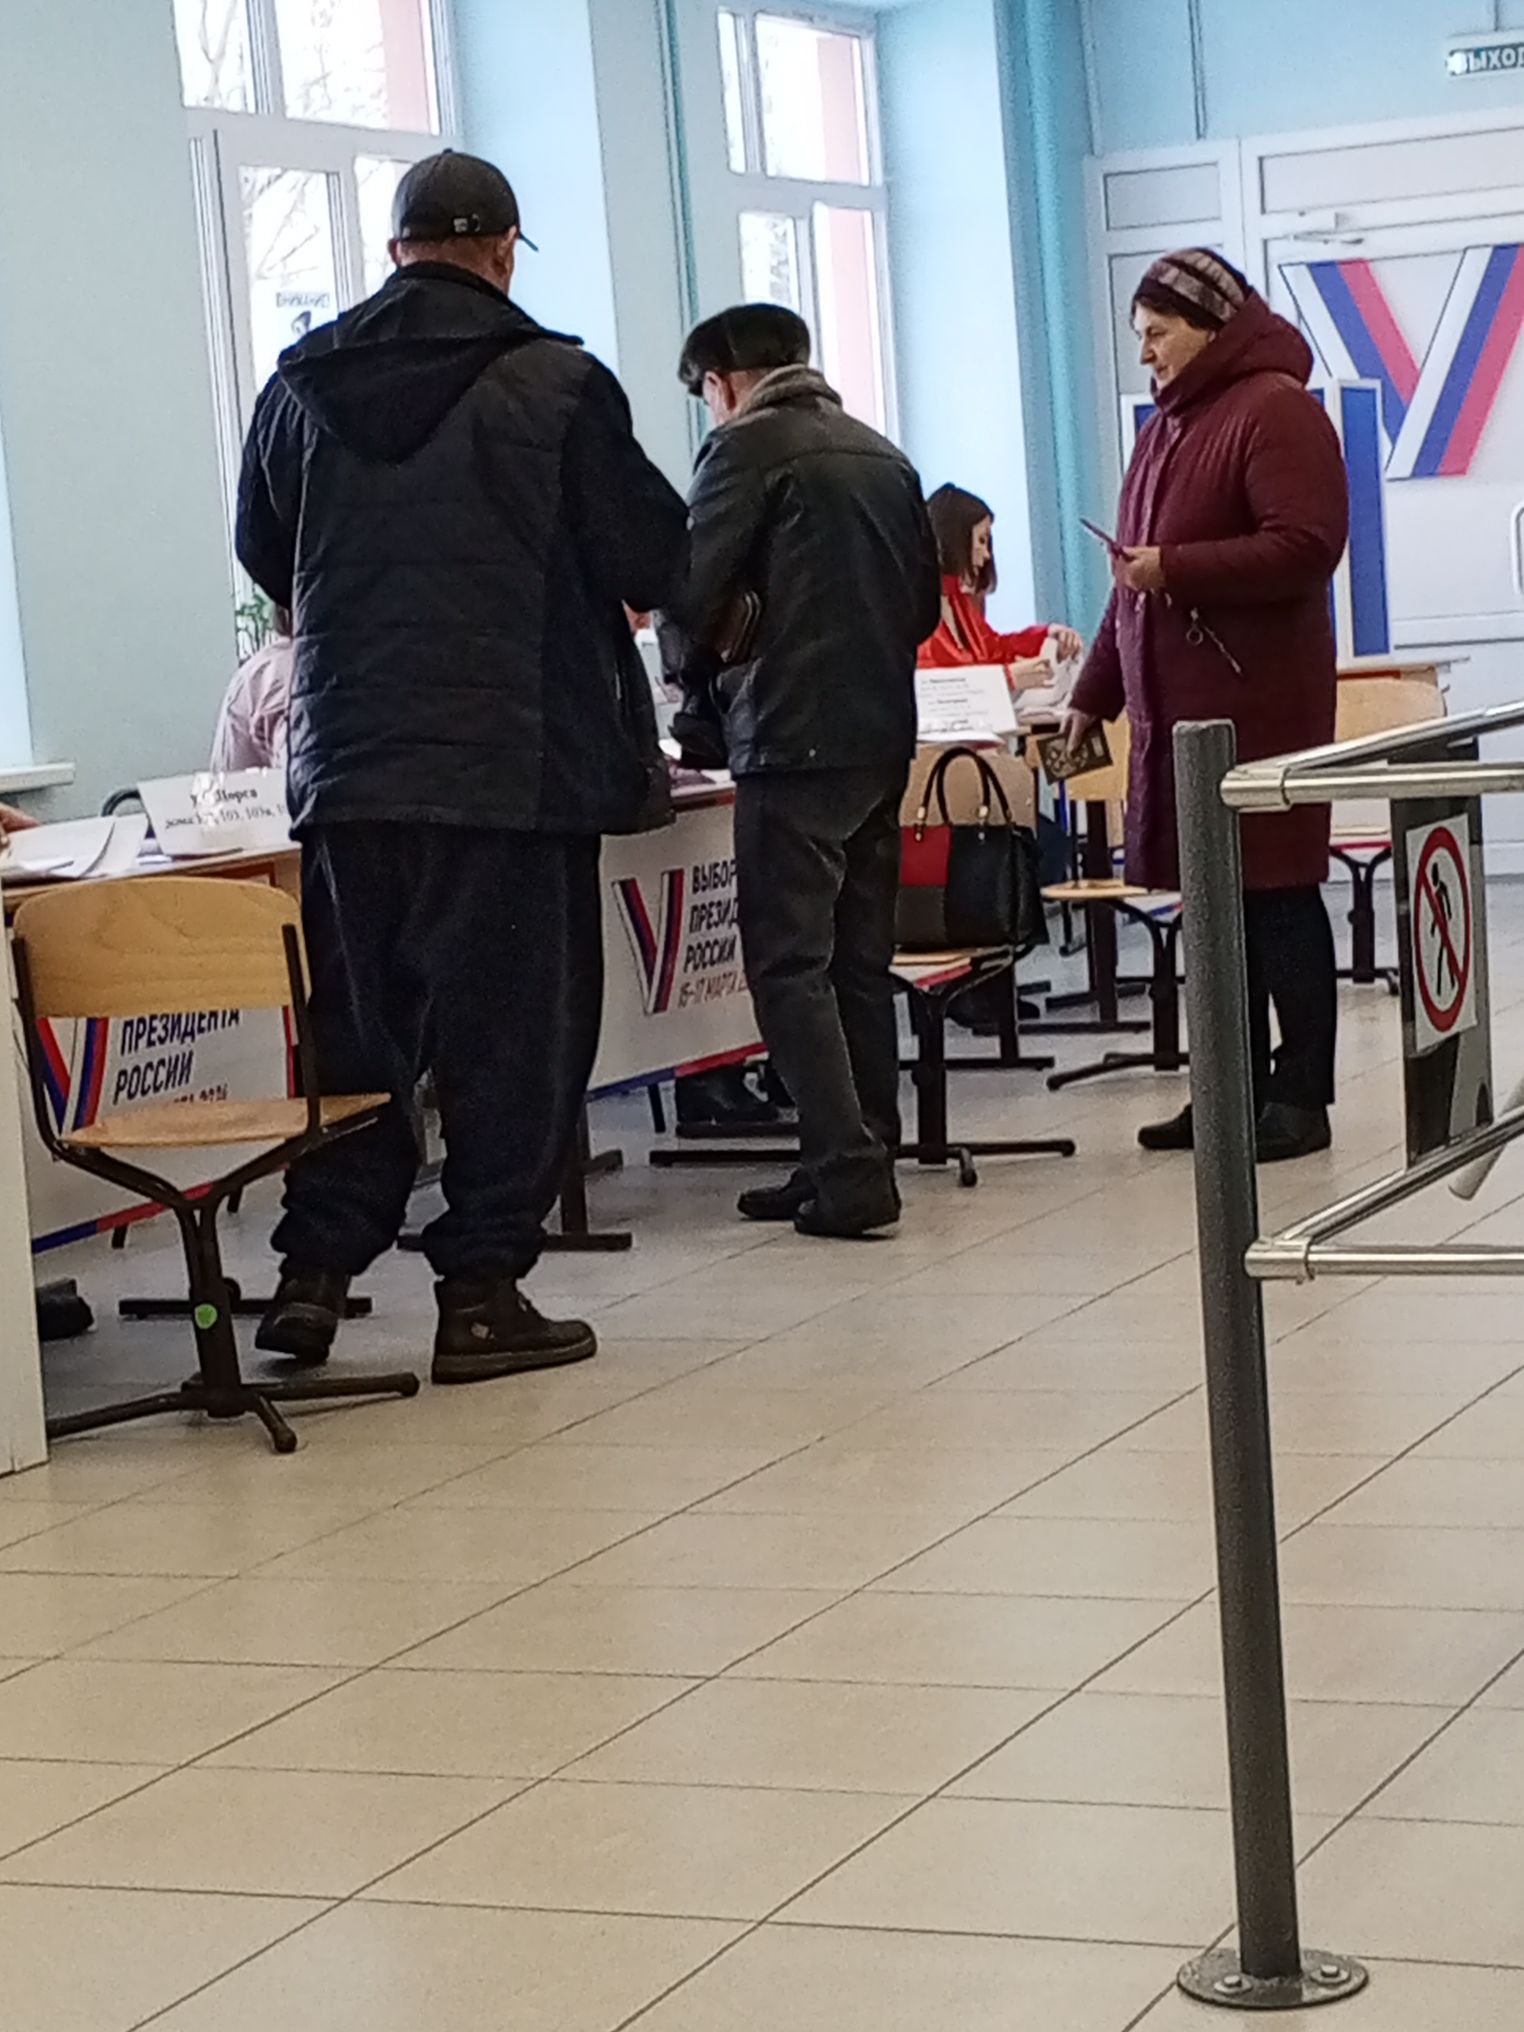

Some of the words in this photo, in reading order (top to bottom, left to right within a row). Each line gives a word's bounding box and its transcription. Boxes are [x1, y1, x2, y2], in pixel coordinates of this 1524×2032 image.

[1453, 46, 1524, 73] ЫХО
[683, 934, 738, 973] РОССИИ
[120, 1008, 240, 1056] ПРЕЗИДЕНТА
[112, 1051, 194, 1105] РОССИИ
